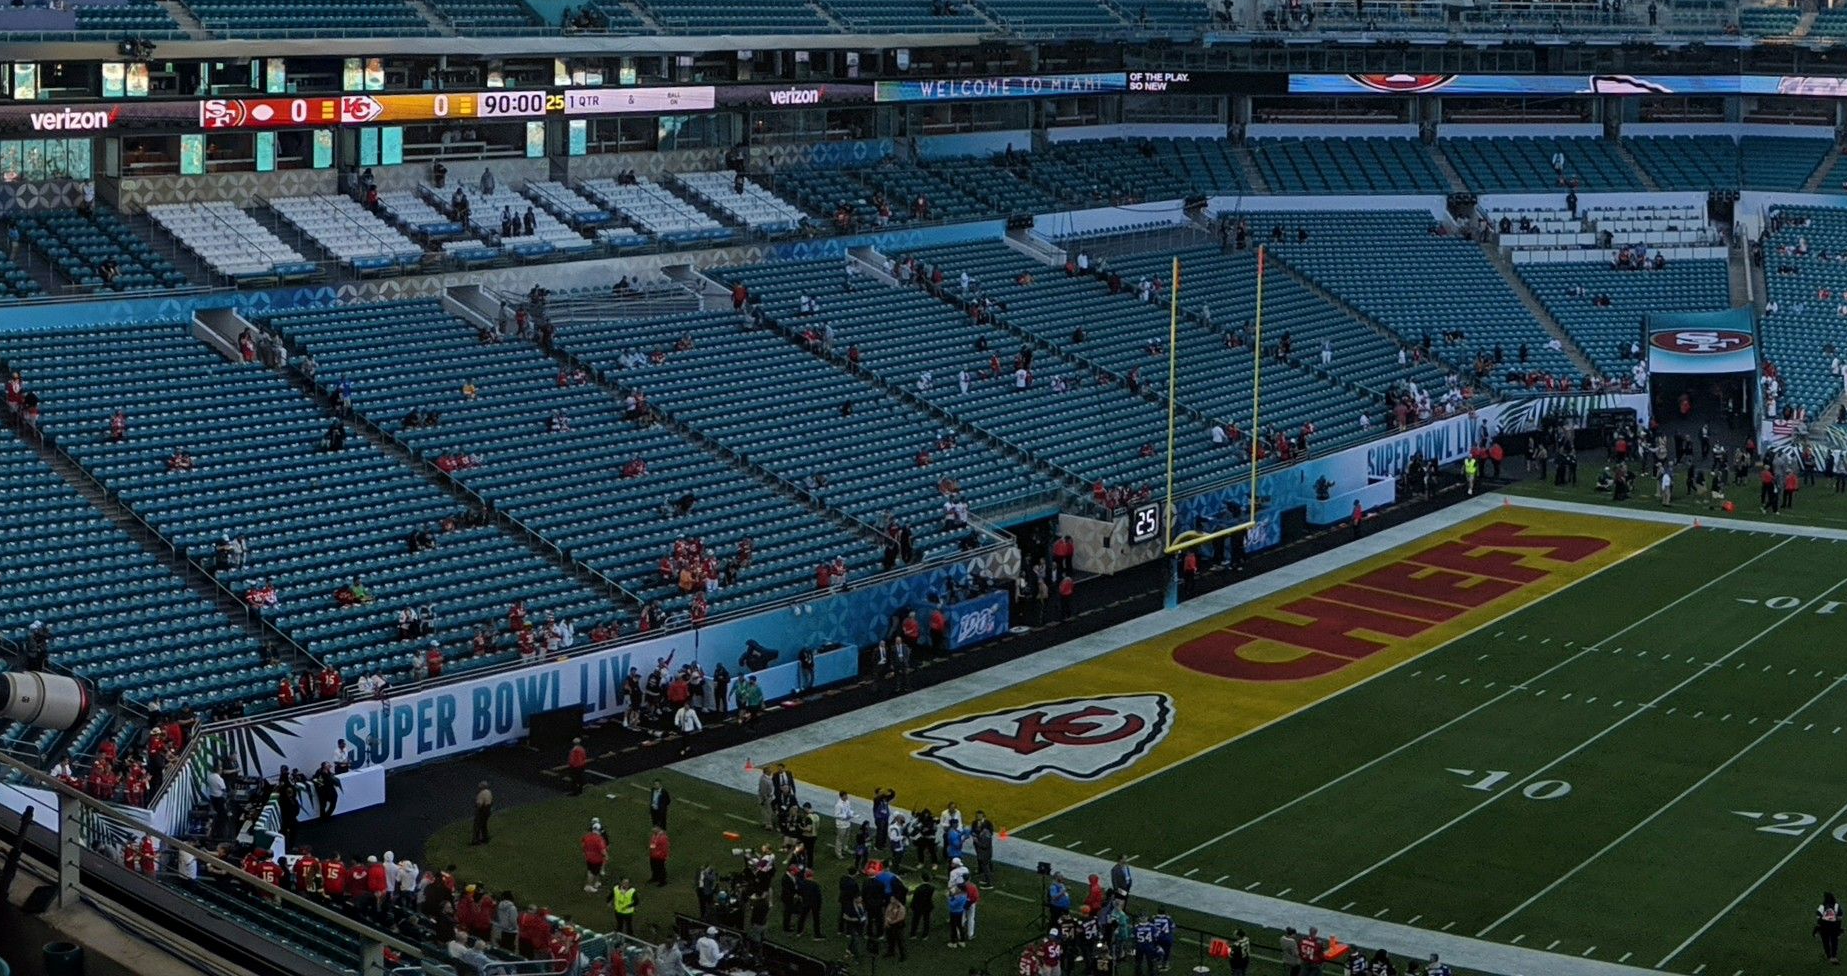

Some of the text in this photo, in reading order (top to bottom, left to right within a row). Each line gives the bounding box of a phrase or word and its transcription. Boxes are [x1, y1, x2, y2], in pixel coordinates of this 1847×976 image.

[769, 88, 818, 105] verizon
[920, 75, 1103, 98] WELCOME TO MIAMI
[291, 100, 307, 122] 0
[433, 94, 448, 117] 0
[485, 93, 543, 115] 90:00
[546, 95, 564, 110] 25
[31, 108, 109, 130] verizon
[1367, 438, 1412, 476] SUPER
[1135, 508, 1156, 534] 25
[1173, 522, 1611, 681] CHIEFS
[346, 692, 456, 769] SUPER
[580, 652, 631, 713] LIV
[1462, 769, 1572, 799] 10
